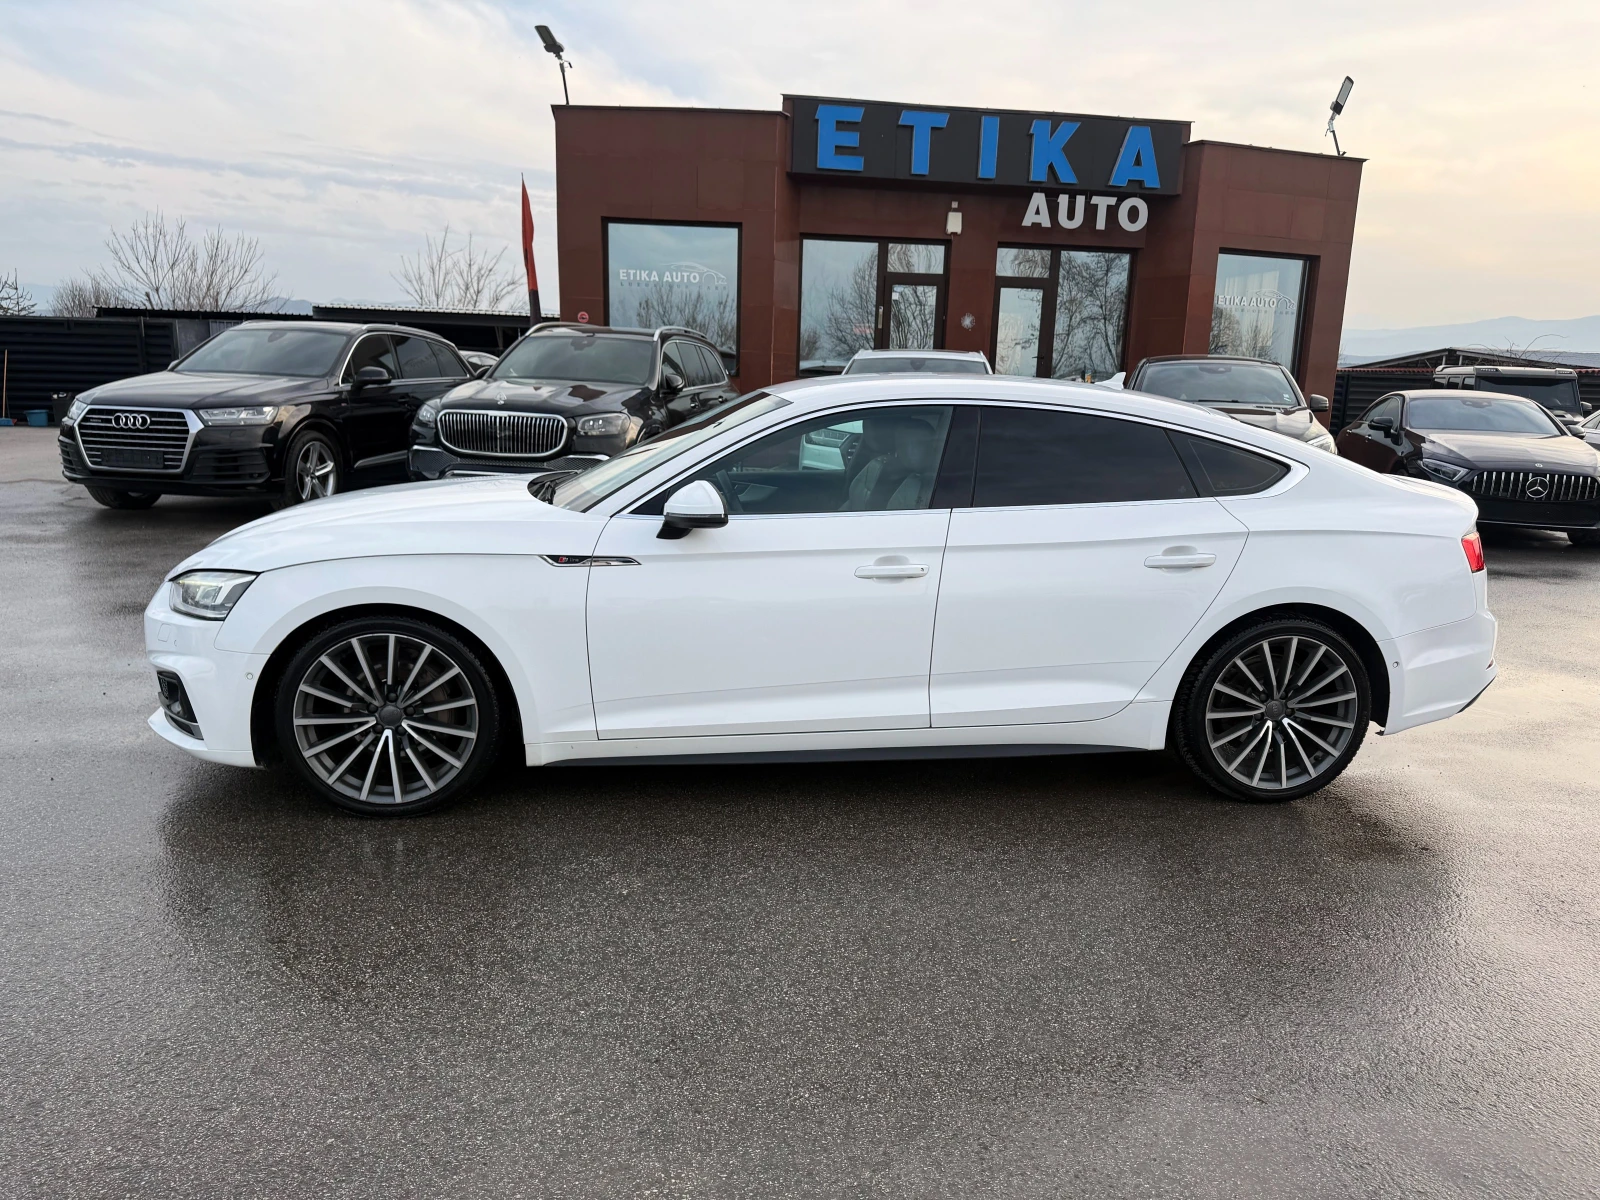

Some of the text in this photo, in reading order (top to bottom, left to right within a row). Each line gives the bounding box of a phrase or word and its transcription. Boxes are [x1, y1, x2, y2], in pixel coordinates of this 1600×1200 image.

[814, 104, 1161, 188] ETIKA
[1021, 192, 1149, 232] AUTO
[620, 270, 700, 282] ETIKA AUTO
[1217, 296, 1276, 308] ETIKA AUTO
